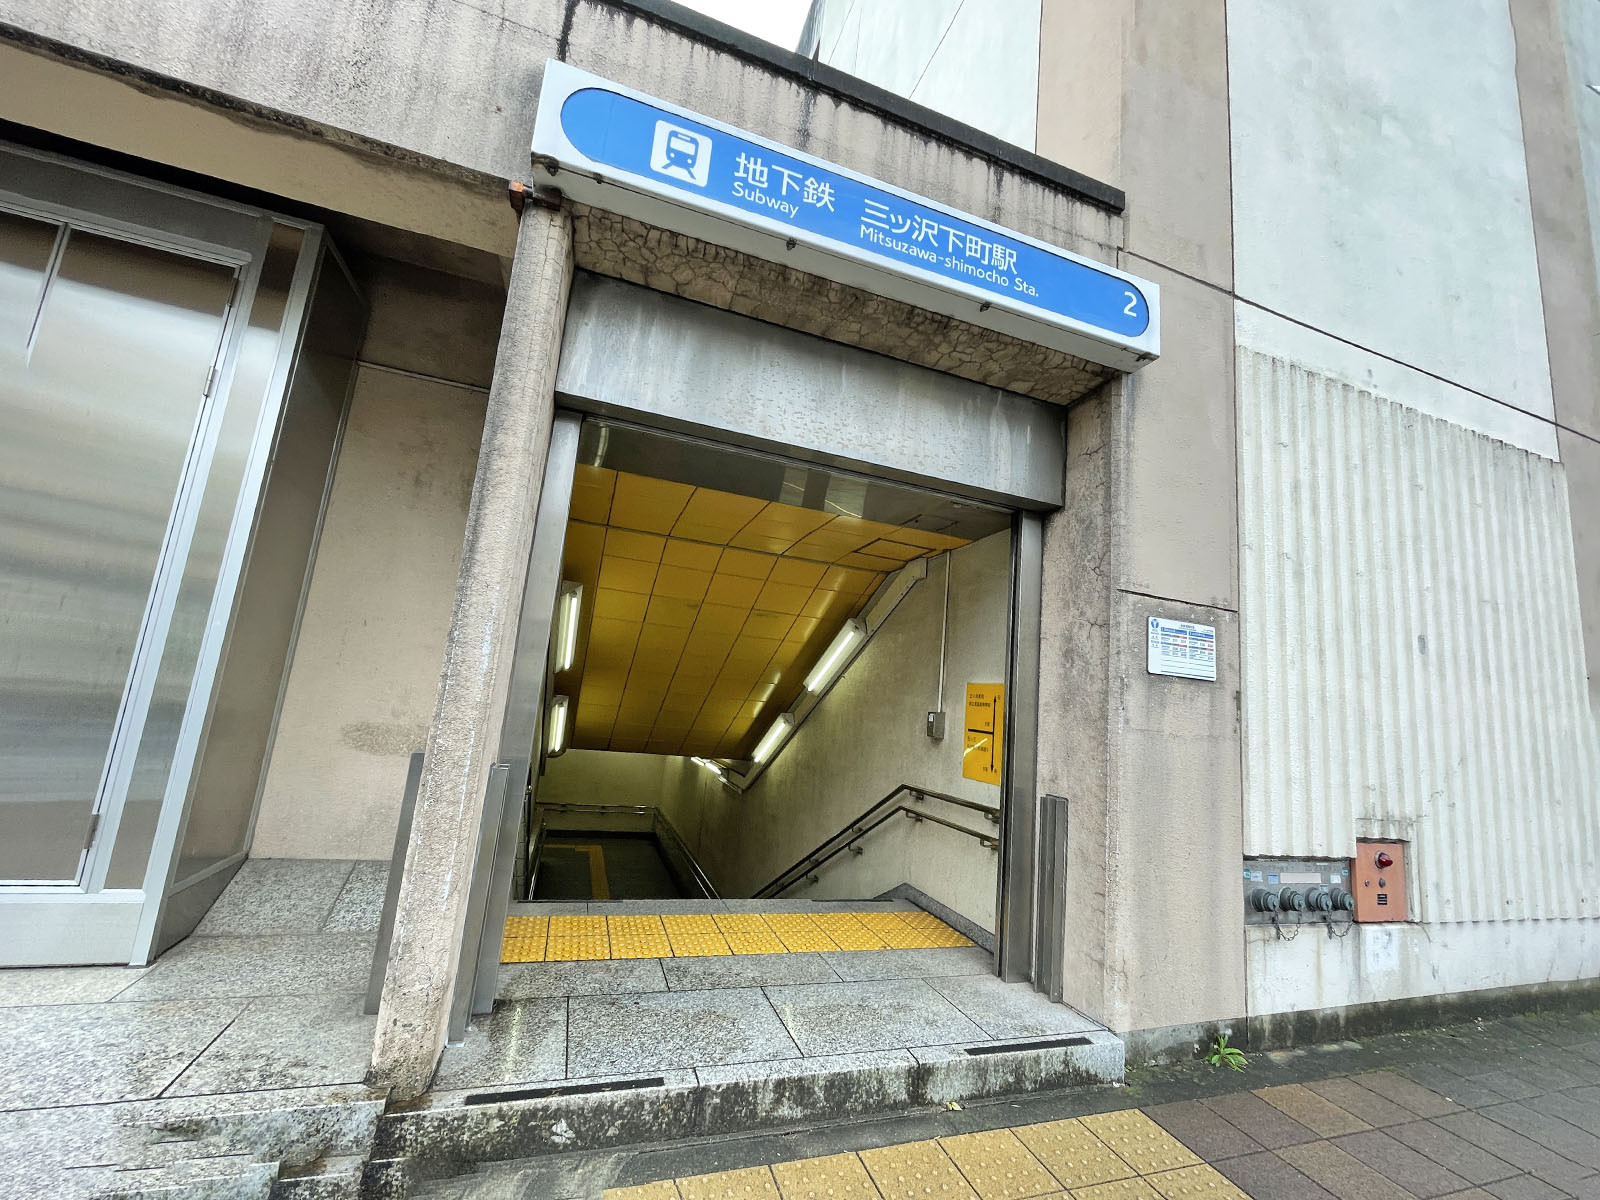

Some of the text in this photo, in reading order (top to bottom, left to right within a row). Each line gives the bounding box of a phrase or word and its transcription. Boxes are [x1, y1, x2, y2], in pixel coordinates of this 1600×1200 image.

[732, 182, 800, 219] Subway
[734, 152, 1018, 275] 地下鉄 三ツ沢下町駅
[860, 225, 1039, 298] Mitsuzawa-shimocho Sta.
[1123, 292, 1138, 317] 2
